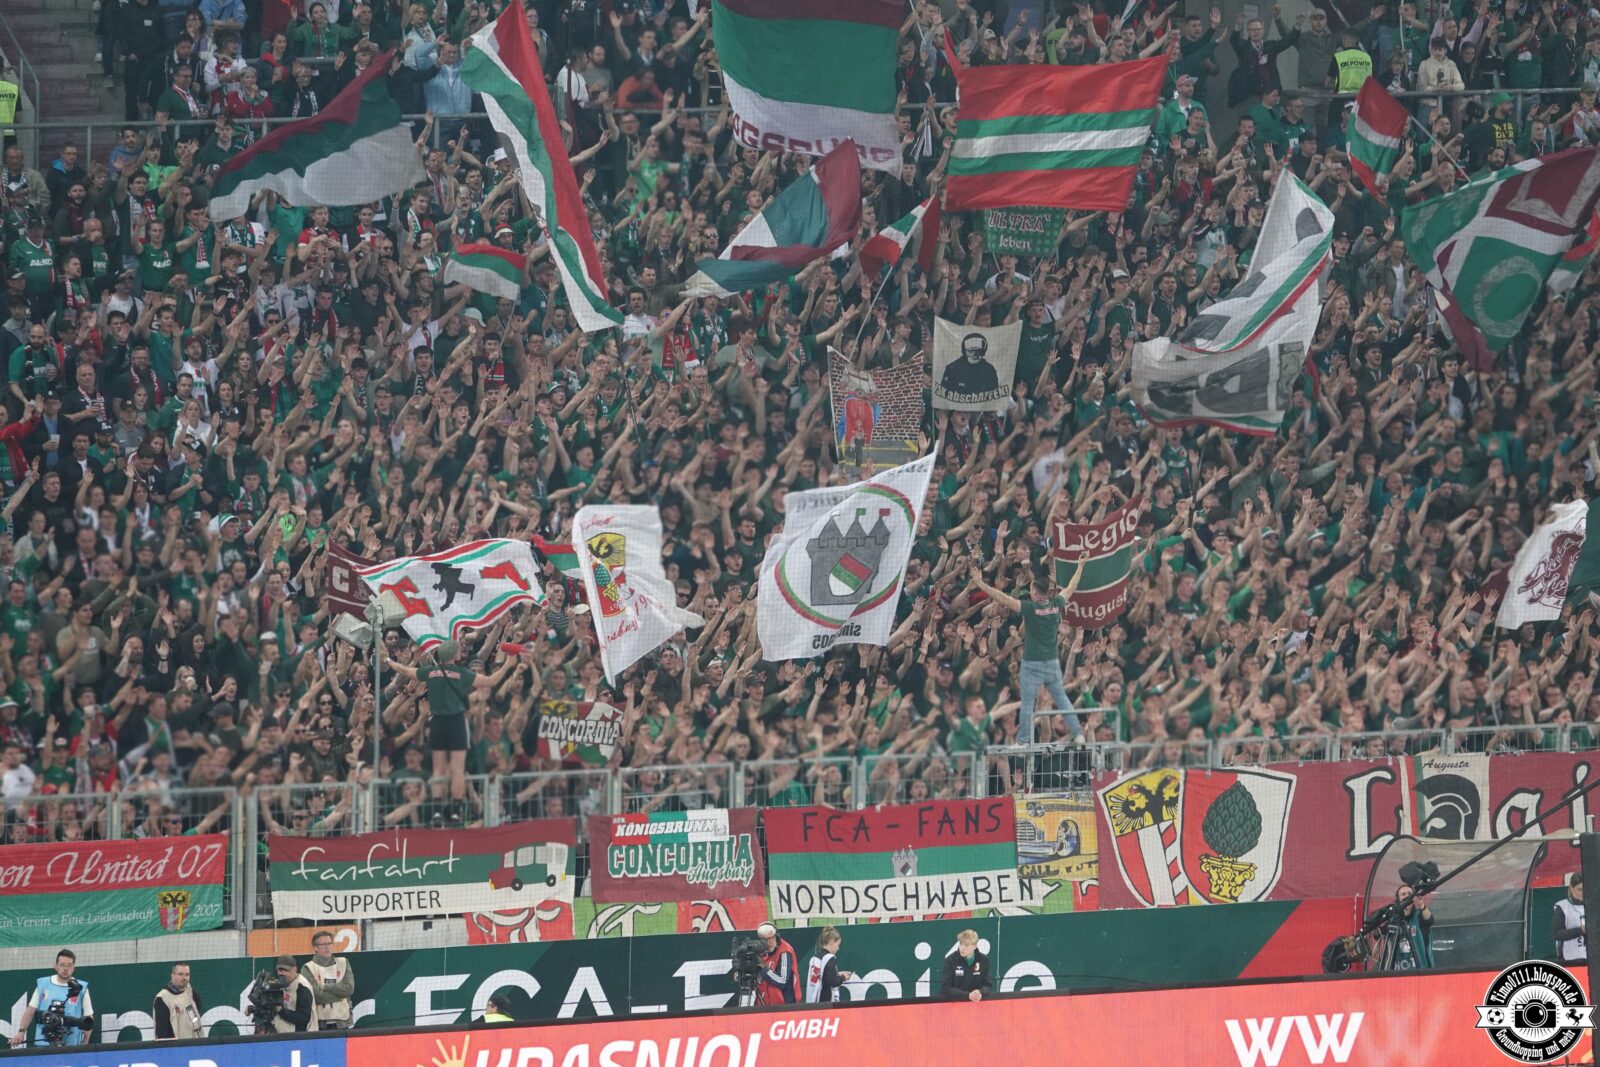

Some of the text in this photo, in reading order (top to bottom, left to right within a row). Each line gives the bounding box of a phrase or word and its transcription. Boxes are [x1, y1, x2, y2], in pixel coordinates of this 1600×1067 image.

[999, 234, 1031, 249] leben
[1055, 508, 1139, 551] Legio
[538, 714, 620, 745] CONCORDIA
[1423, 758, 1471, 771] Augusta
[803, 811, 870, 842] FCA
[918, 803, 1003, 837] FANS
[47, 850, 174, 886] United
[177, 843, 223, 879] 07
[608, 834, 754, 878] CONCORDIA
[687, 862, 755, 889] Augsburg
[321, 889, 442, 914] SUPPORTER
[777, 874, 1034, 914] NORDSCHWABEN
[16, 916, 51, 929] Verein
[61, 913, 85, 926] Eine
[87, 909, 154, 924] Leidenschaft
[193, 903, 219, 917] 2007
[768, 1017, 840, 1041] GMBH
